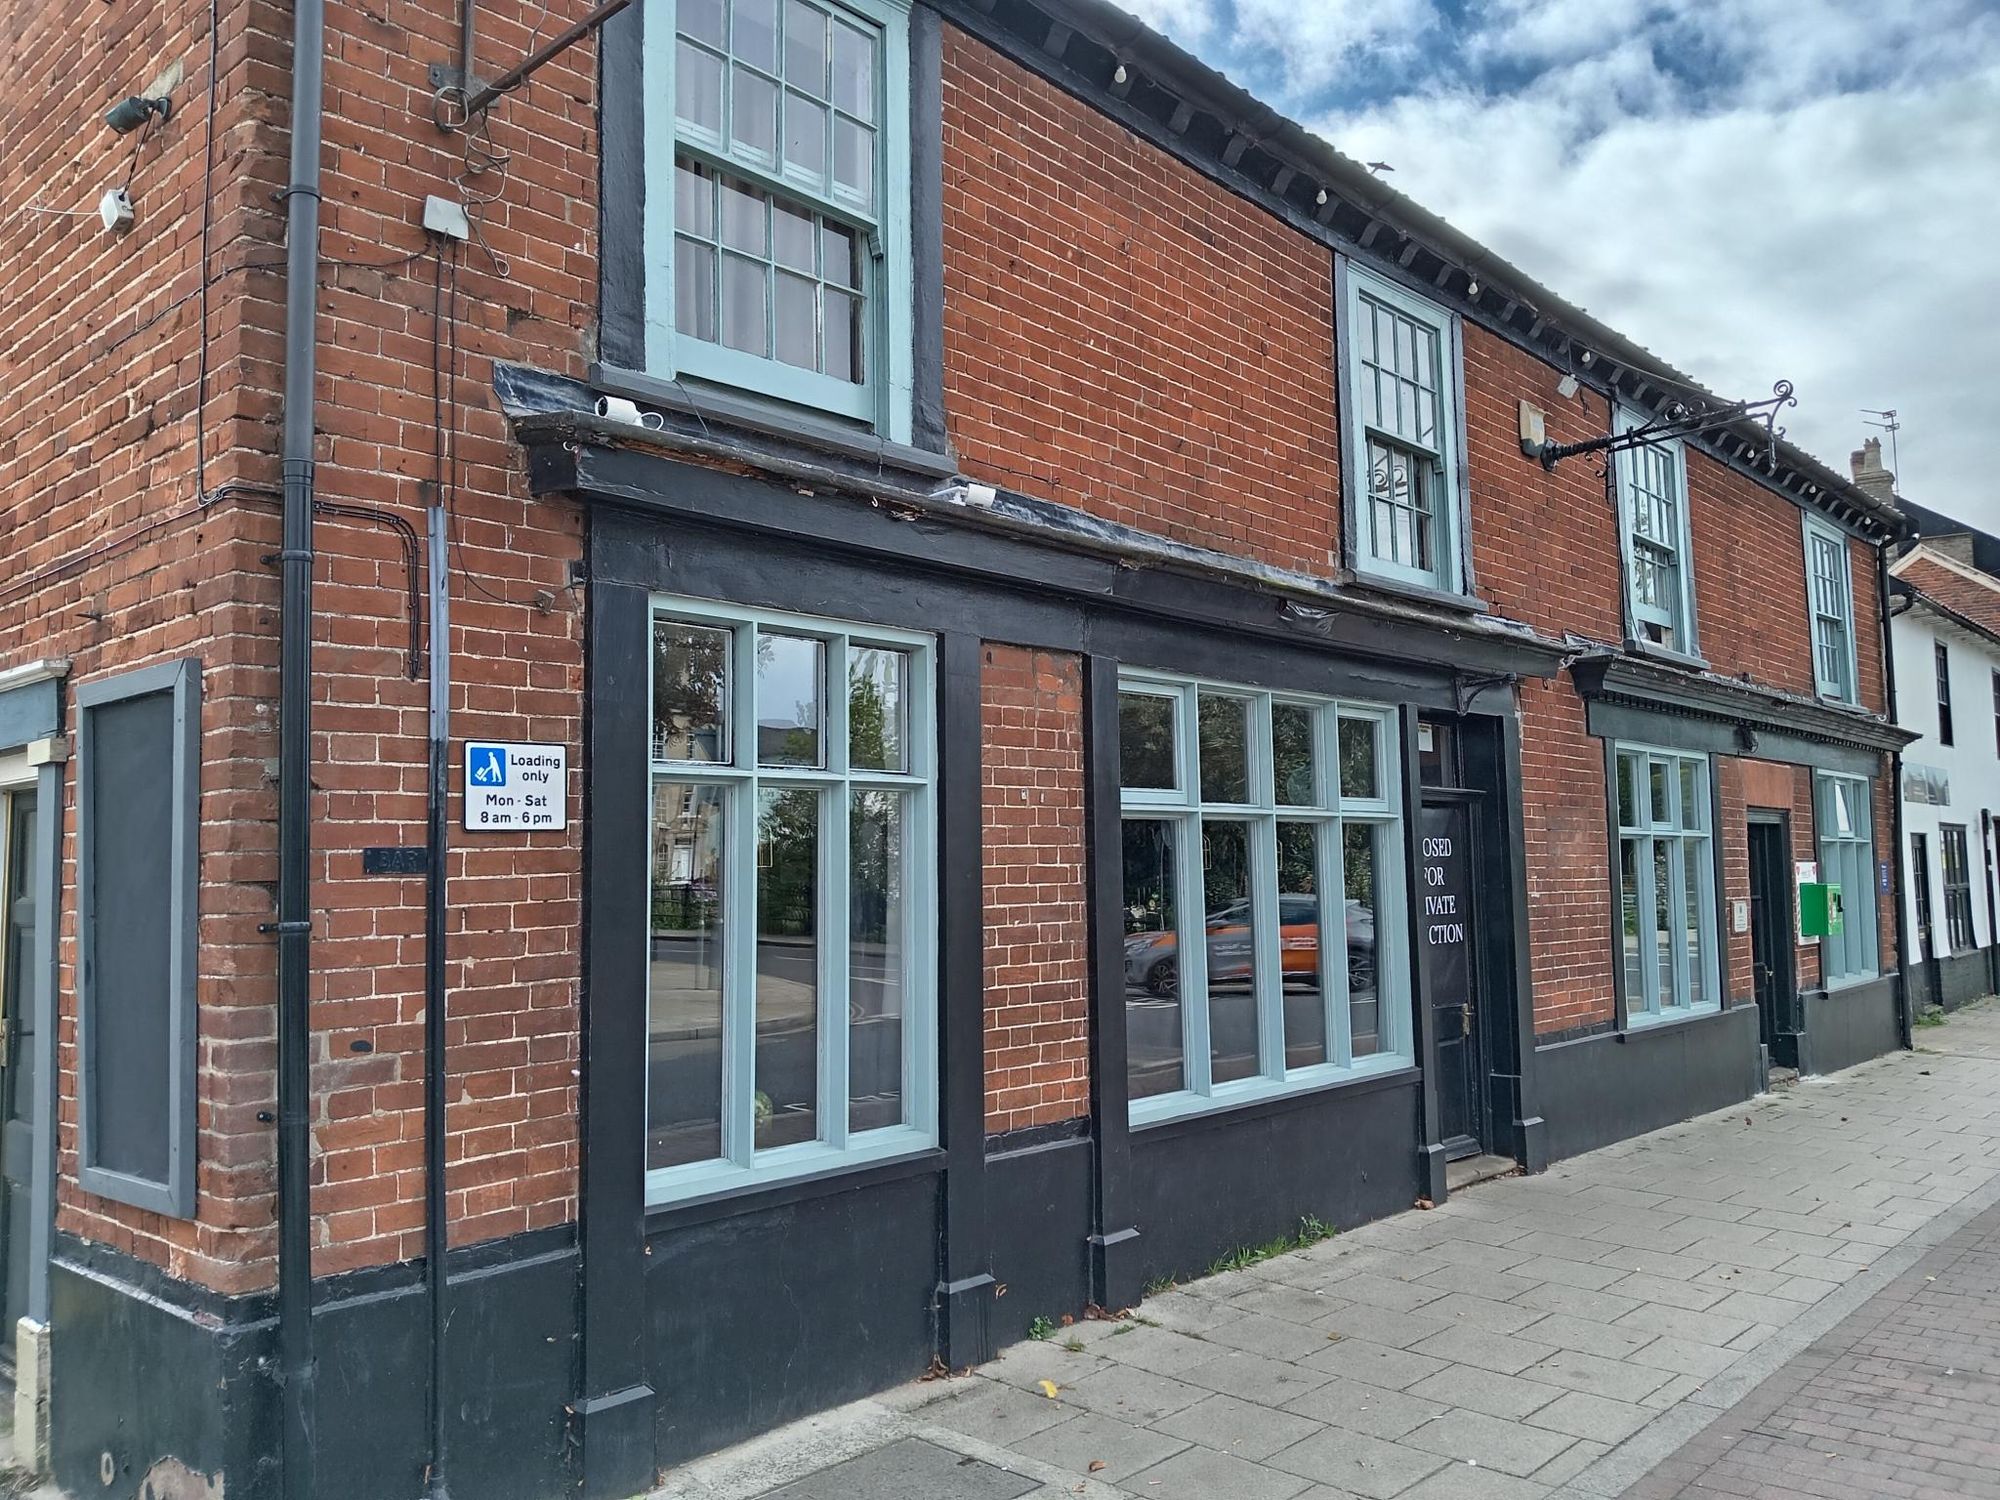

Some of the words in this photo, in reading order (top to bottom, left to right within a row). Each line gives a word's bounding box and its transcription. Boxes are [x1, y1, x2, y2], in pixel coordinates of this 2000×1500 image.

[511, 754, 561, 769] Loading
[522, 770, 549, 783] only
[486, 794, 514, 806] Mon
[525, 794, 547, 806] Sat
[1422, 837, 1452, 857] OSED
[1425, 895, 1456, 915] IVATE
[1428, 923, 1464, 945] CTION
